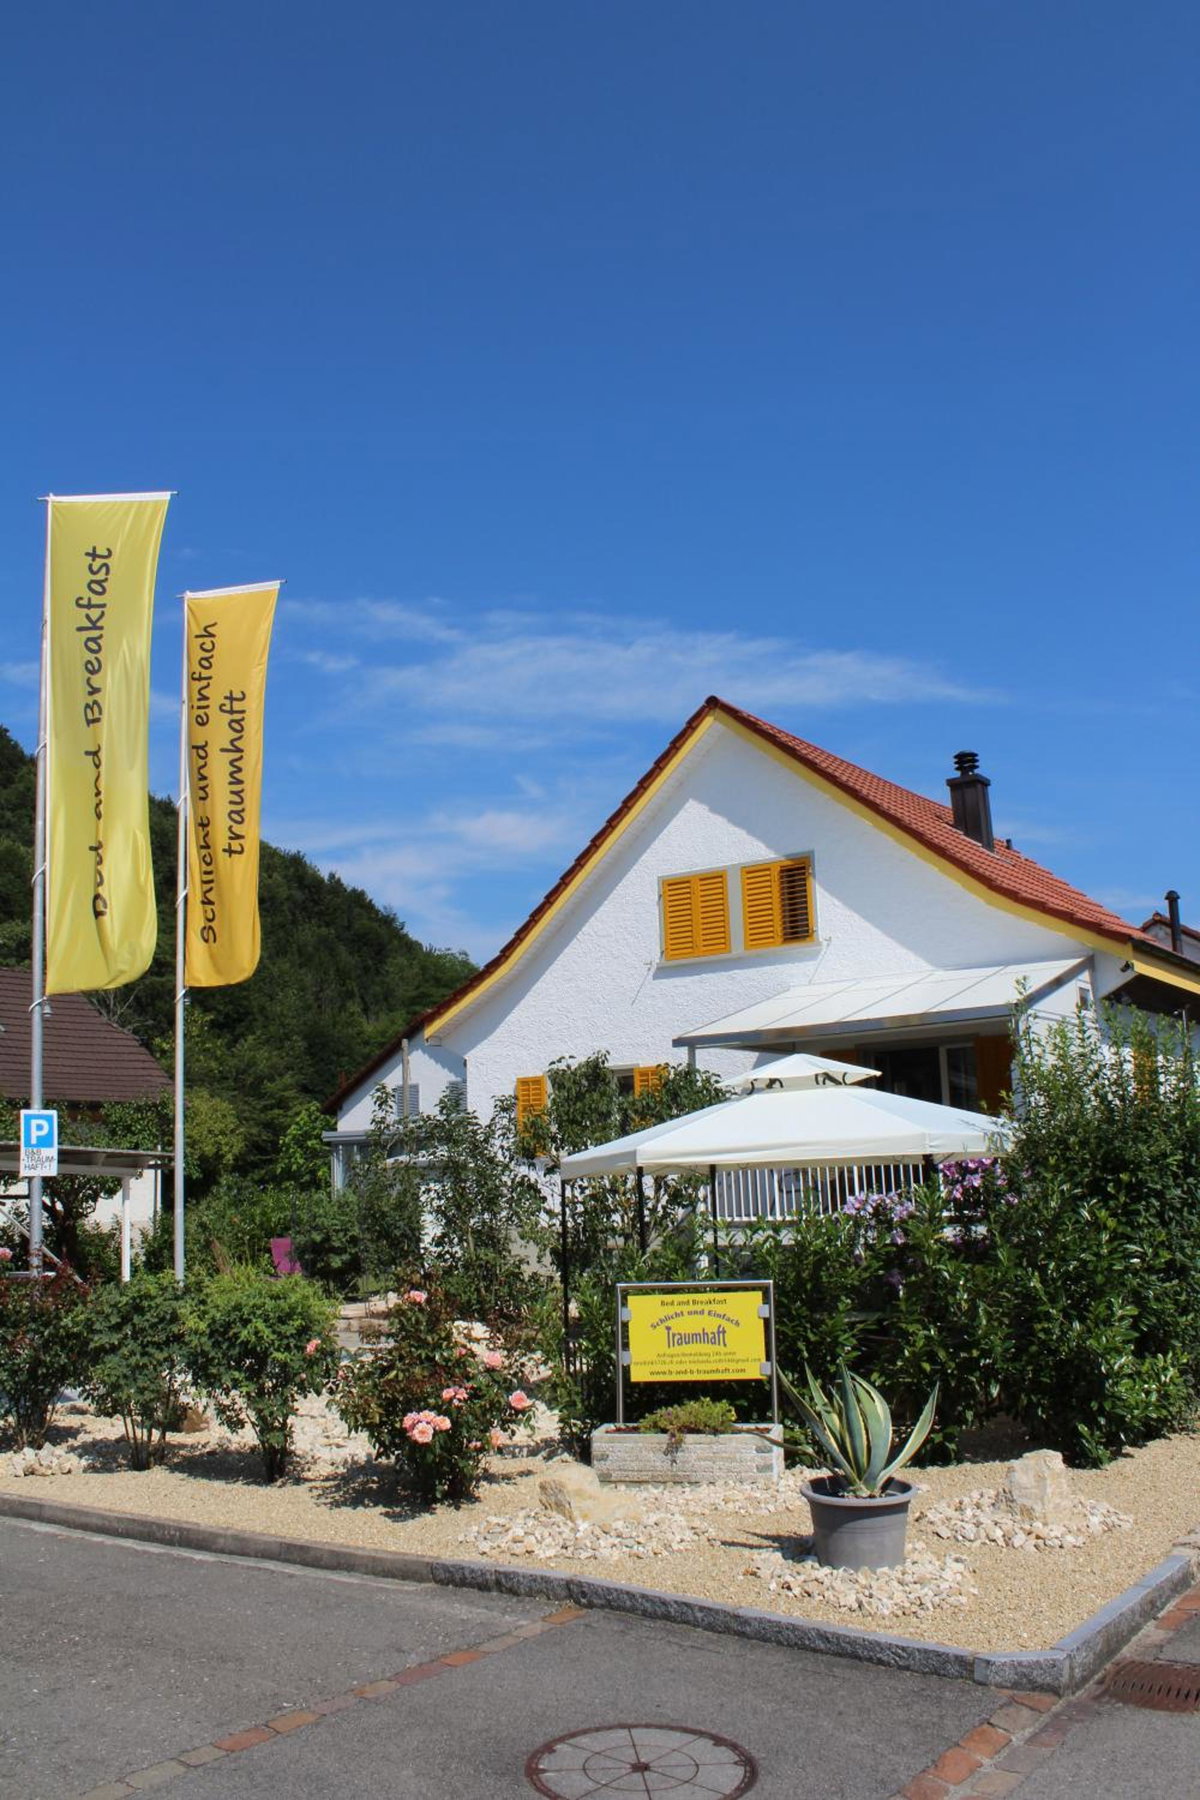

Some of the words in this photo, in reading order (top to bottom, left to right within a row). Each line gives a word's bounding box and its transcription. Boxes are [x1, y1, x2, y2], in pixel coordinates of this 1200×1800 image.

[75, 546, 113, 728] Breakfast
[190, 622, 218, 727] einfach
[84, 743, 103, 821] and
[192, 740, 209, 801] und
[219, 689, 247, 857] traumhaft
[197, 816, 216, 944] Schlicht
[30, 1119, 49, 1145] P
[650, 1310, 685, 1329] Schlicht
[707, 1309, 740, 1327] Einfach
[665, 1324, 727, 1349] Traumhaft
